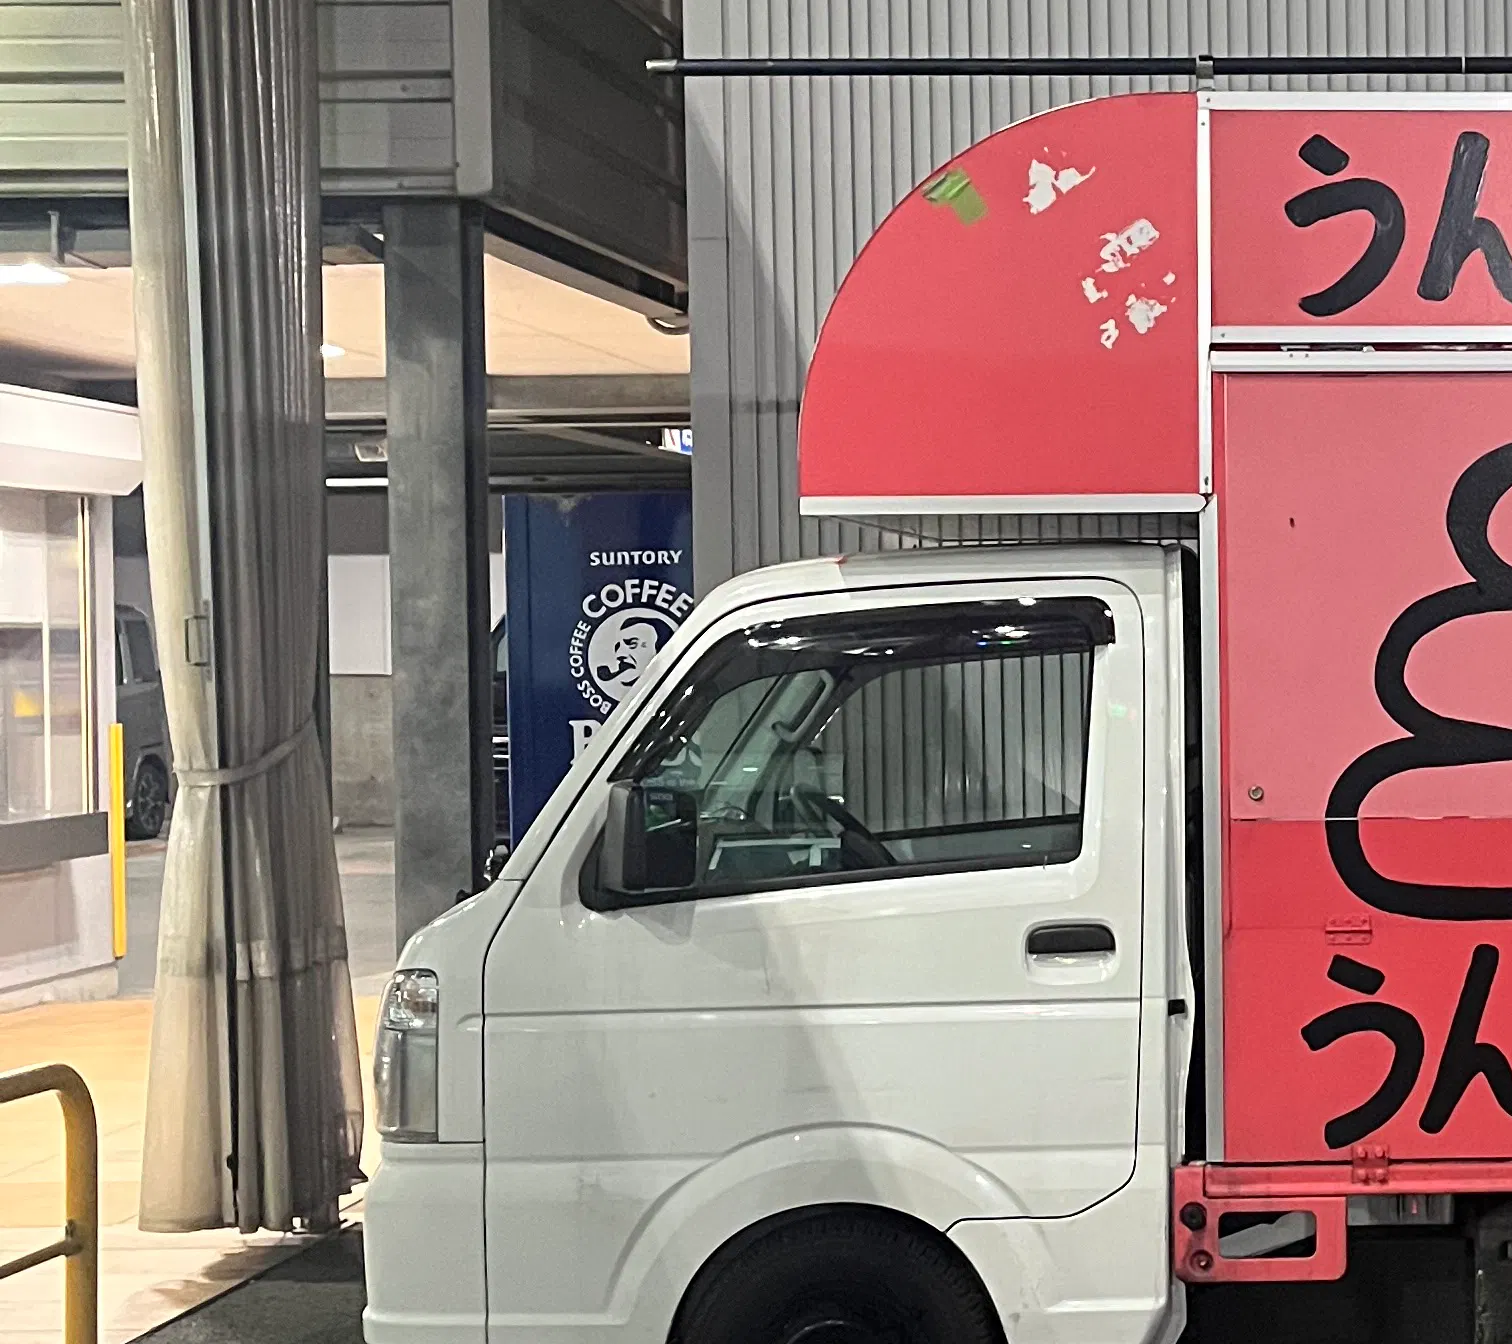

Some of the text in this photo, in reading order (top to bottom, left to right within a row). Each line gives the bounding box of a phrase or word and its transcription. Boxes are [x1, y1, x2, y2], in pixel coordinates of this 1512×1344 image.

[589, 549, 683, 567] SUNTORY
[582, 578, 695, 618] COFFEE
[569, 620, 612, 715] BOSS COFFEE
